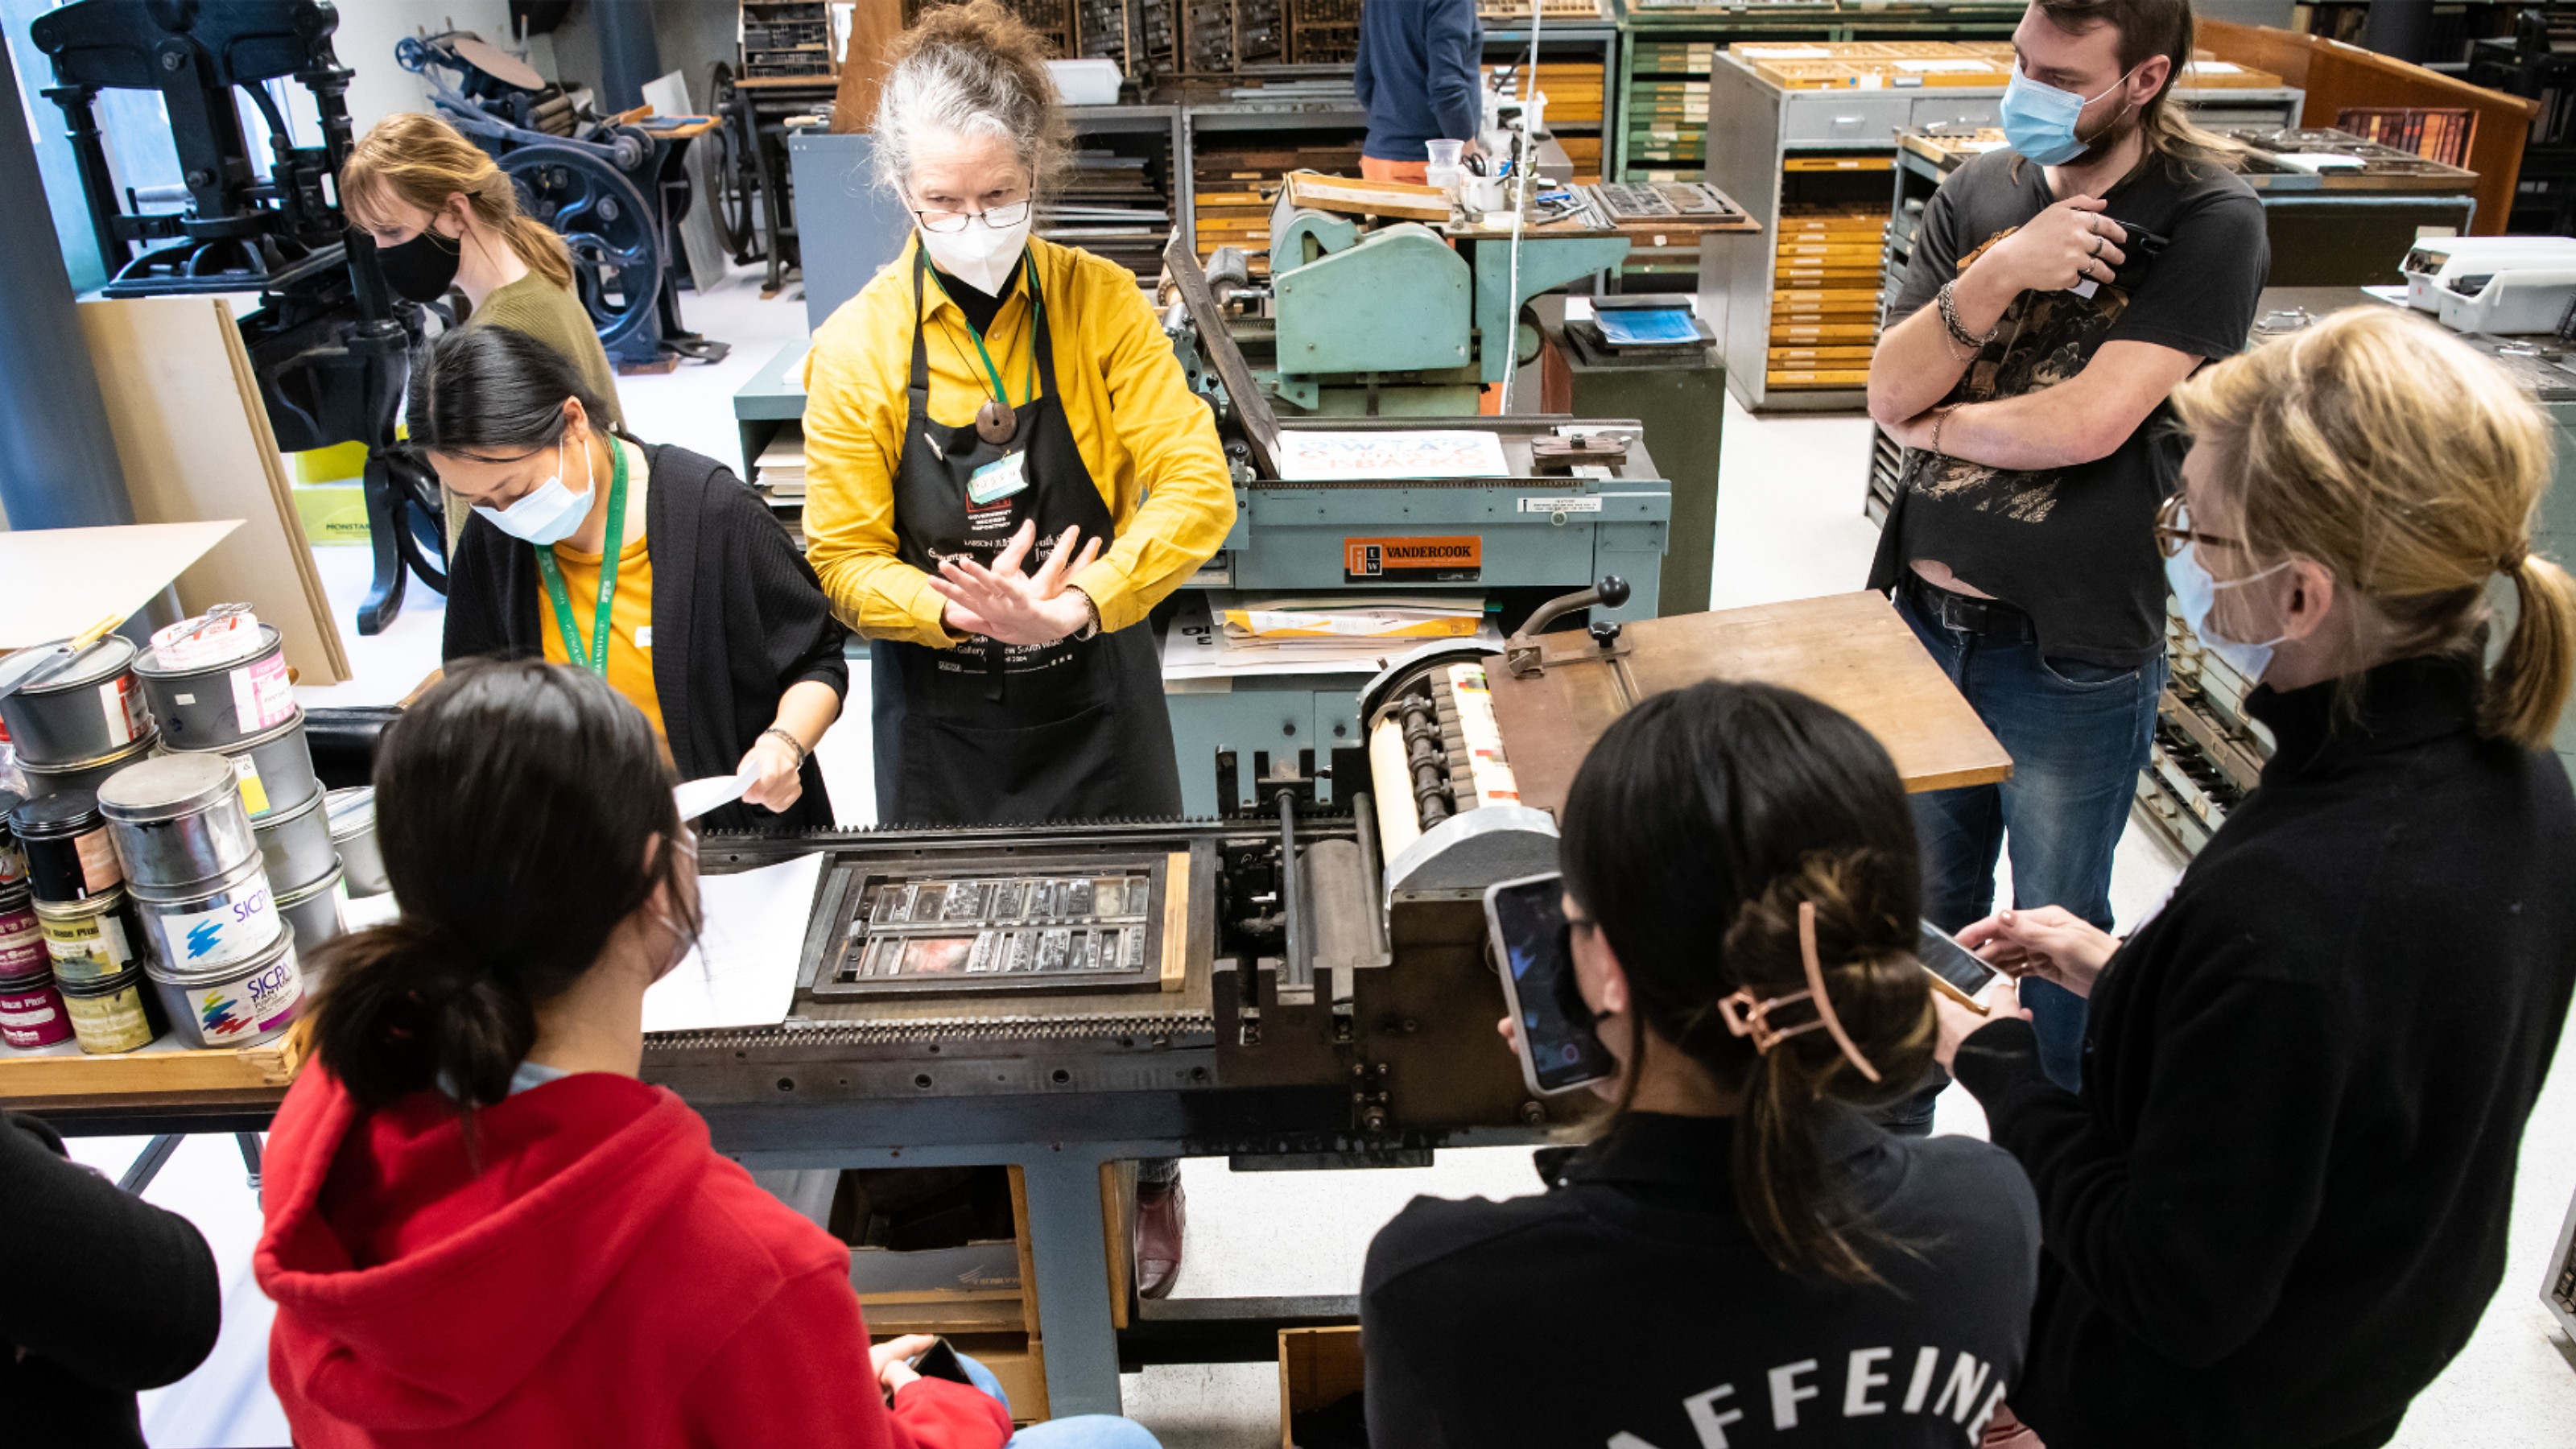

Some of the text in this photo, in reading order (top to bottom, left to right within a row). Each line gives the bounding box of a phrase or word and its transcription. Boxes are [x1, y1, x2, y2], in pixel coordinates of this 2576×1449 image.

[1386, 546, 1472, 558] VANDERCOOK
[1017, 643, 1042, 654] South
[76, 927, 100, 936] Plus
[247, 961, 293, 1000] SICPA
[24, 996, 47, 1007] Plus
